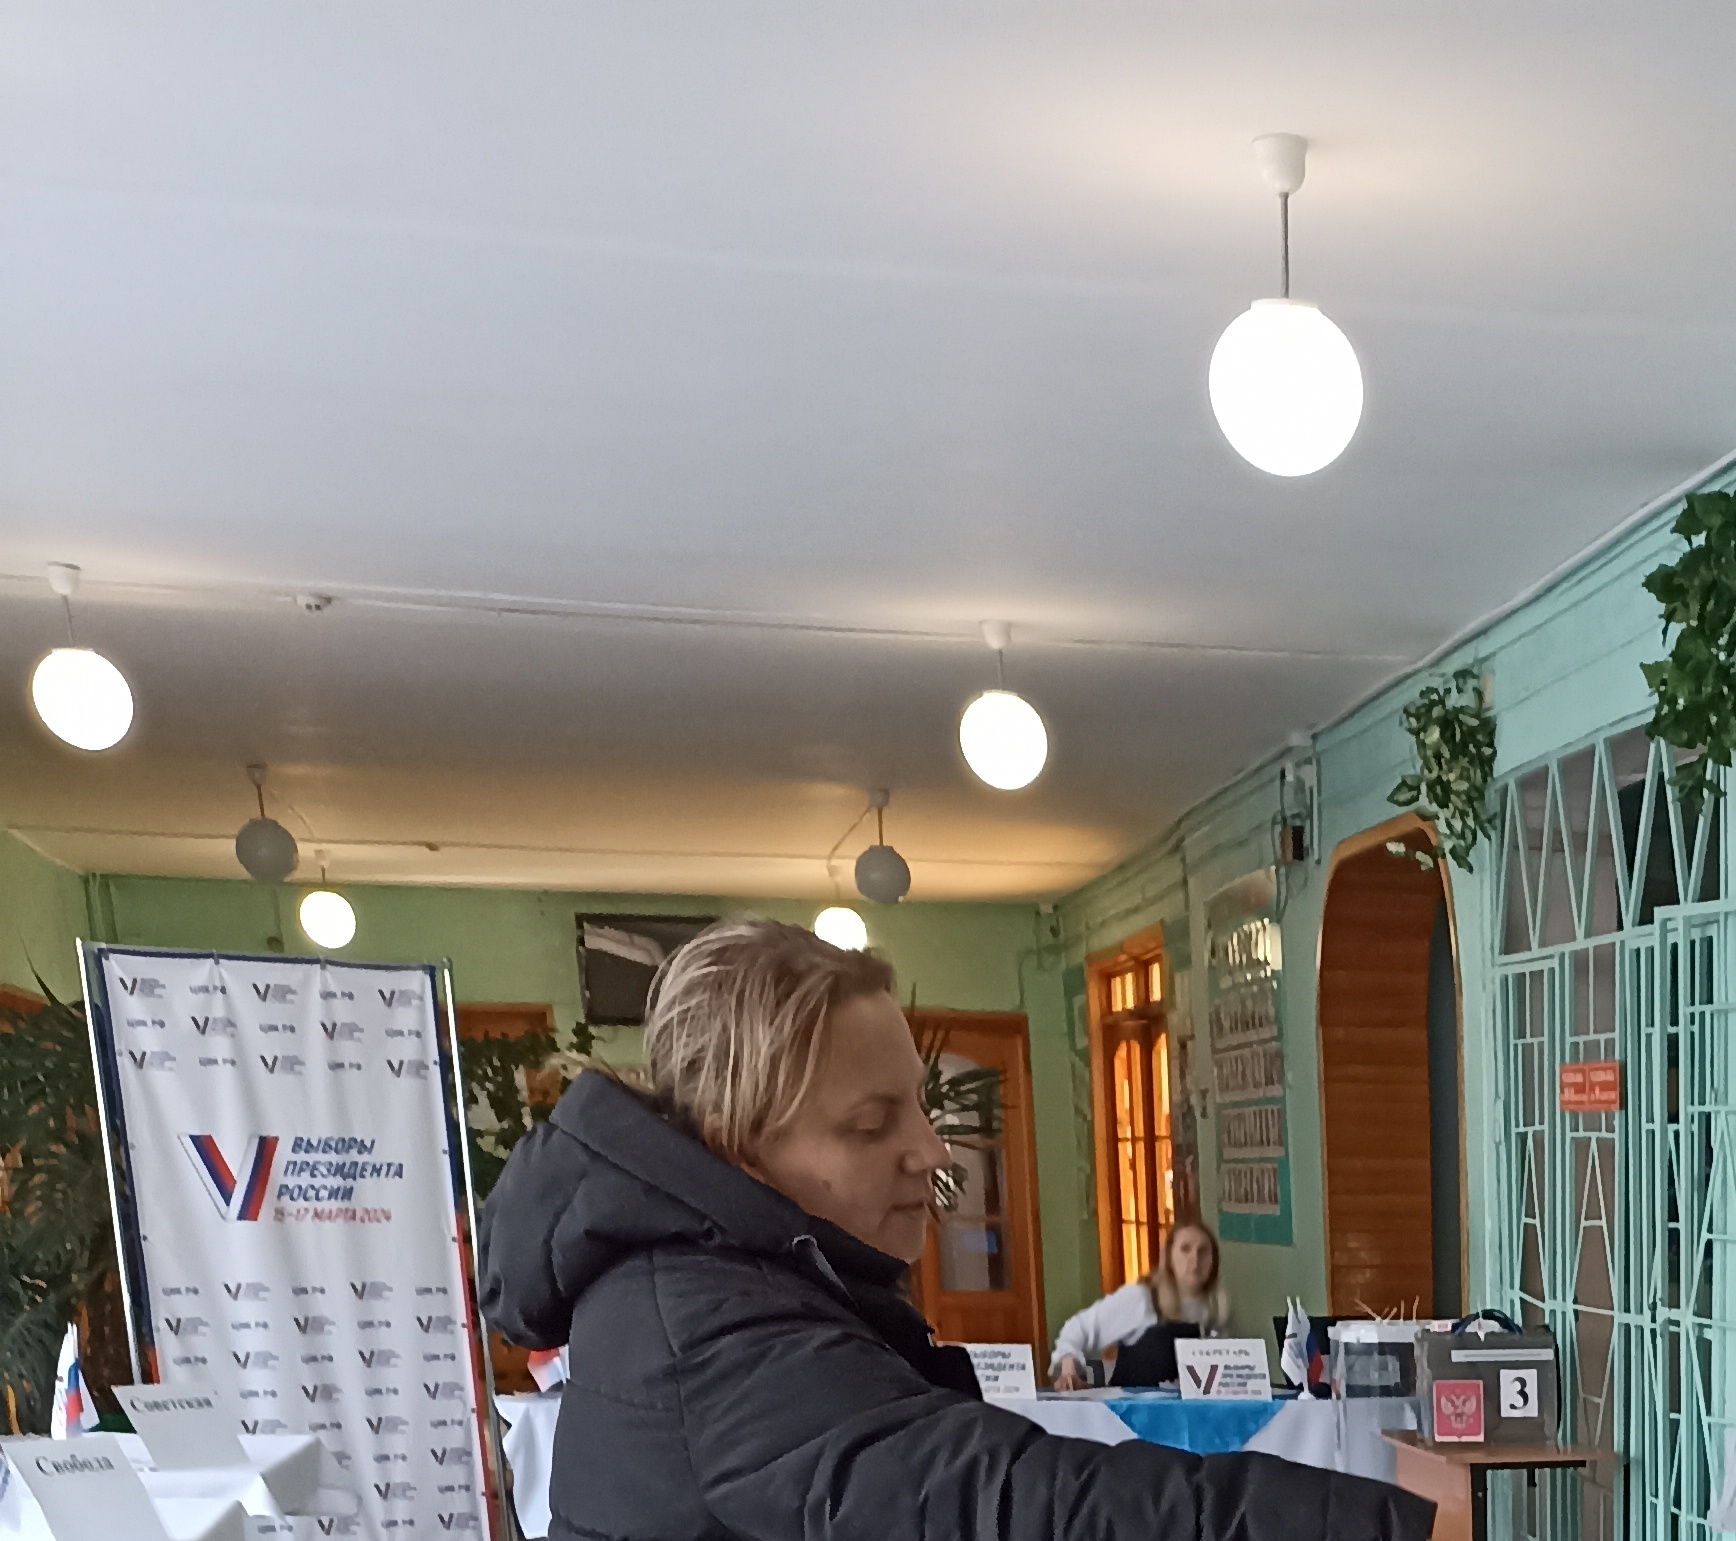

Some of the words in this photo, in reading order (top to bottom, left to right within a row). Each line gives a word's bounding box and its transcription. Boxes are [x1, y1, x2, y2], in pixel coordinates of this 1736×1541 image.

[291, 1136, 376, 1155] ВЫБОРЫ
[283, 1160, 404, 1181] ПРЕЗИДЕНТА
[276, 1184, 354, 1202] РОССИИ
[1509, 1376, 1529, 1410] 3
